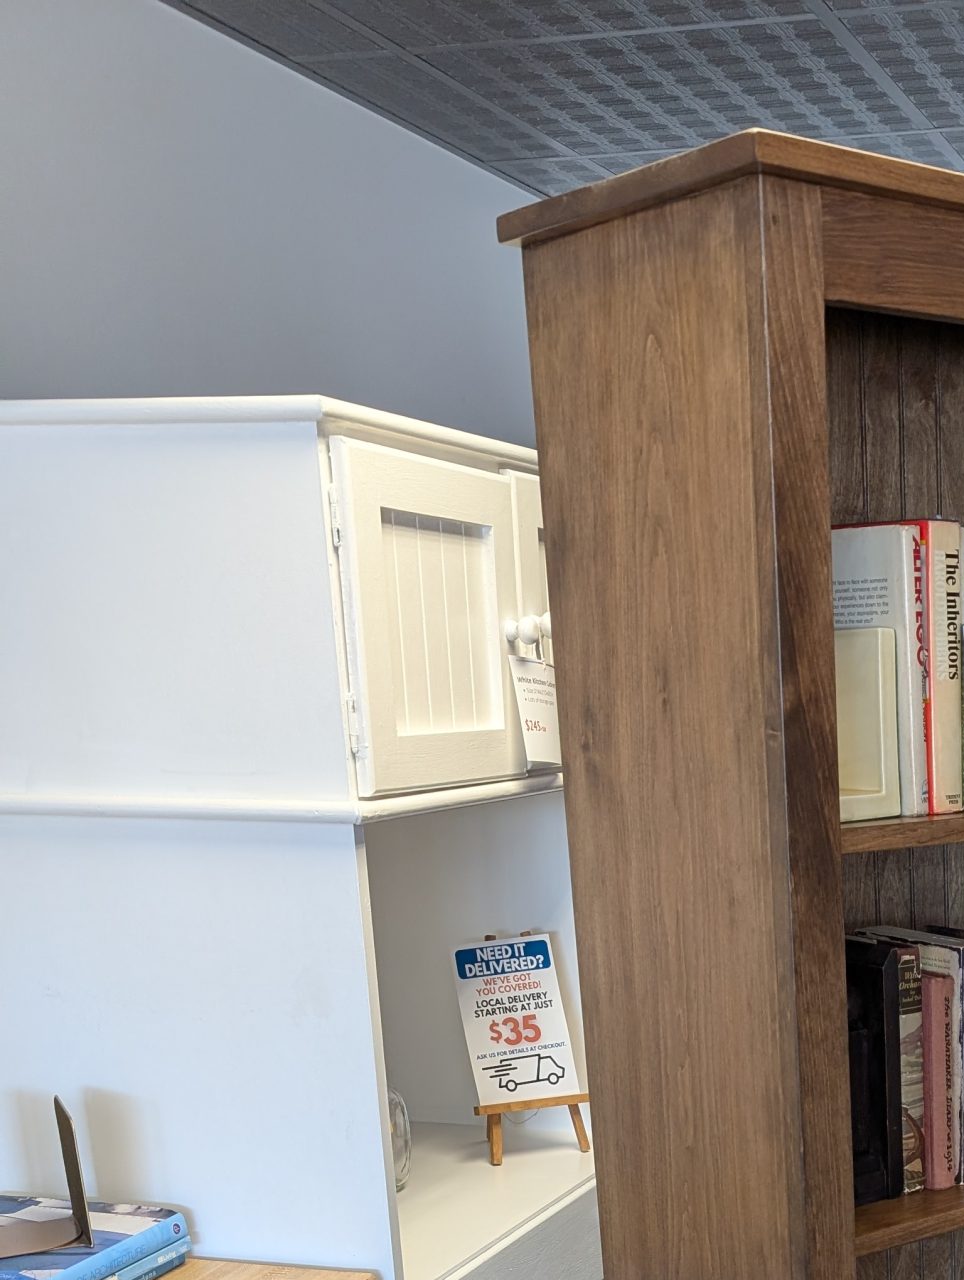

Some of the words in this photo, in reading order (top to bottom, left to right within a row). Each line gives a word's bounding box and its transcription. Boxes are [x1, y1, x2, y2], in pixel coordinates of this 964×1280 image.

[945, 549, 959, 586] The
[946, 592, 961, 680] Inheritors
[475, 945, 512, 962] NEED
[513, 943, 526, 957] IT
[464, 955, 544, 977] DELIVERED?
[512, 973, 532, 982] GOT
[475, 987, 496, 997] YOU
[497, 980, 542, 994] COVERED!
[474, 1004, 518, 1019] STARTING
[520, 1002, 532, 1012] AT
[533, 999, 553, 1010] JUST
[475, 997, 506, 1009] LOCAL
[507, 991, 548, 1005] DELIVERY
[489, 1013, 542, 1046] $35
[508, 1047, 529, 1056] DETAILS
[90, 1244, 147, 1280] ARCHITECTURE
